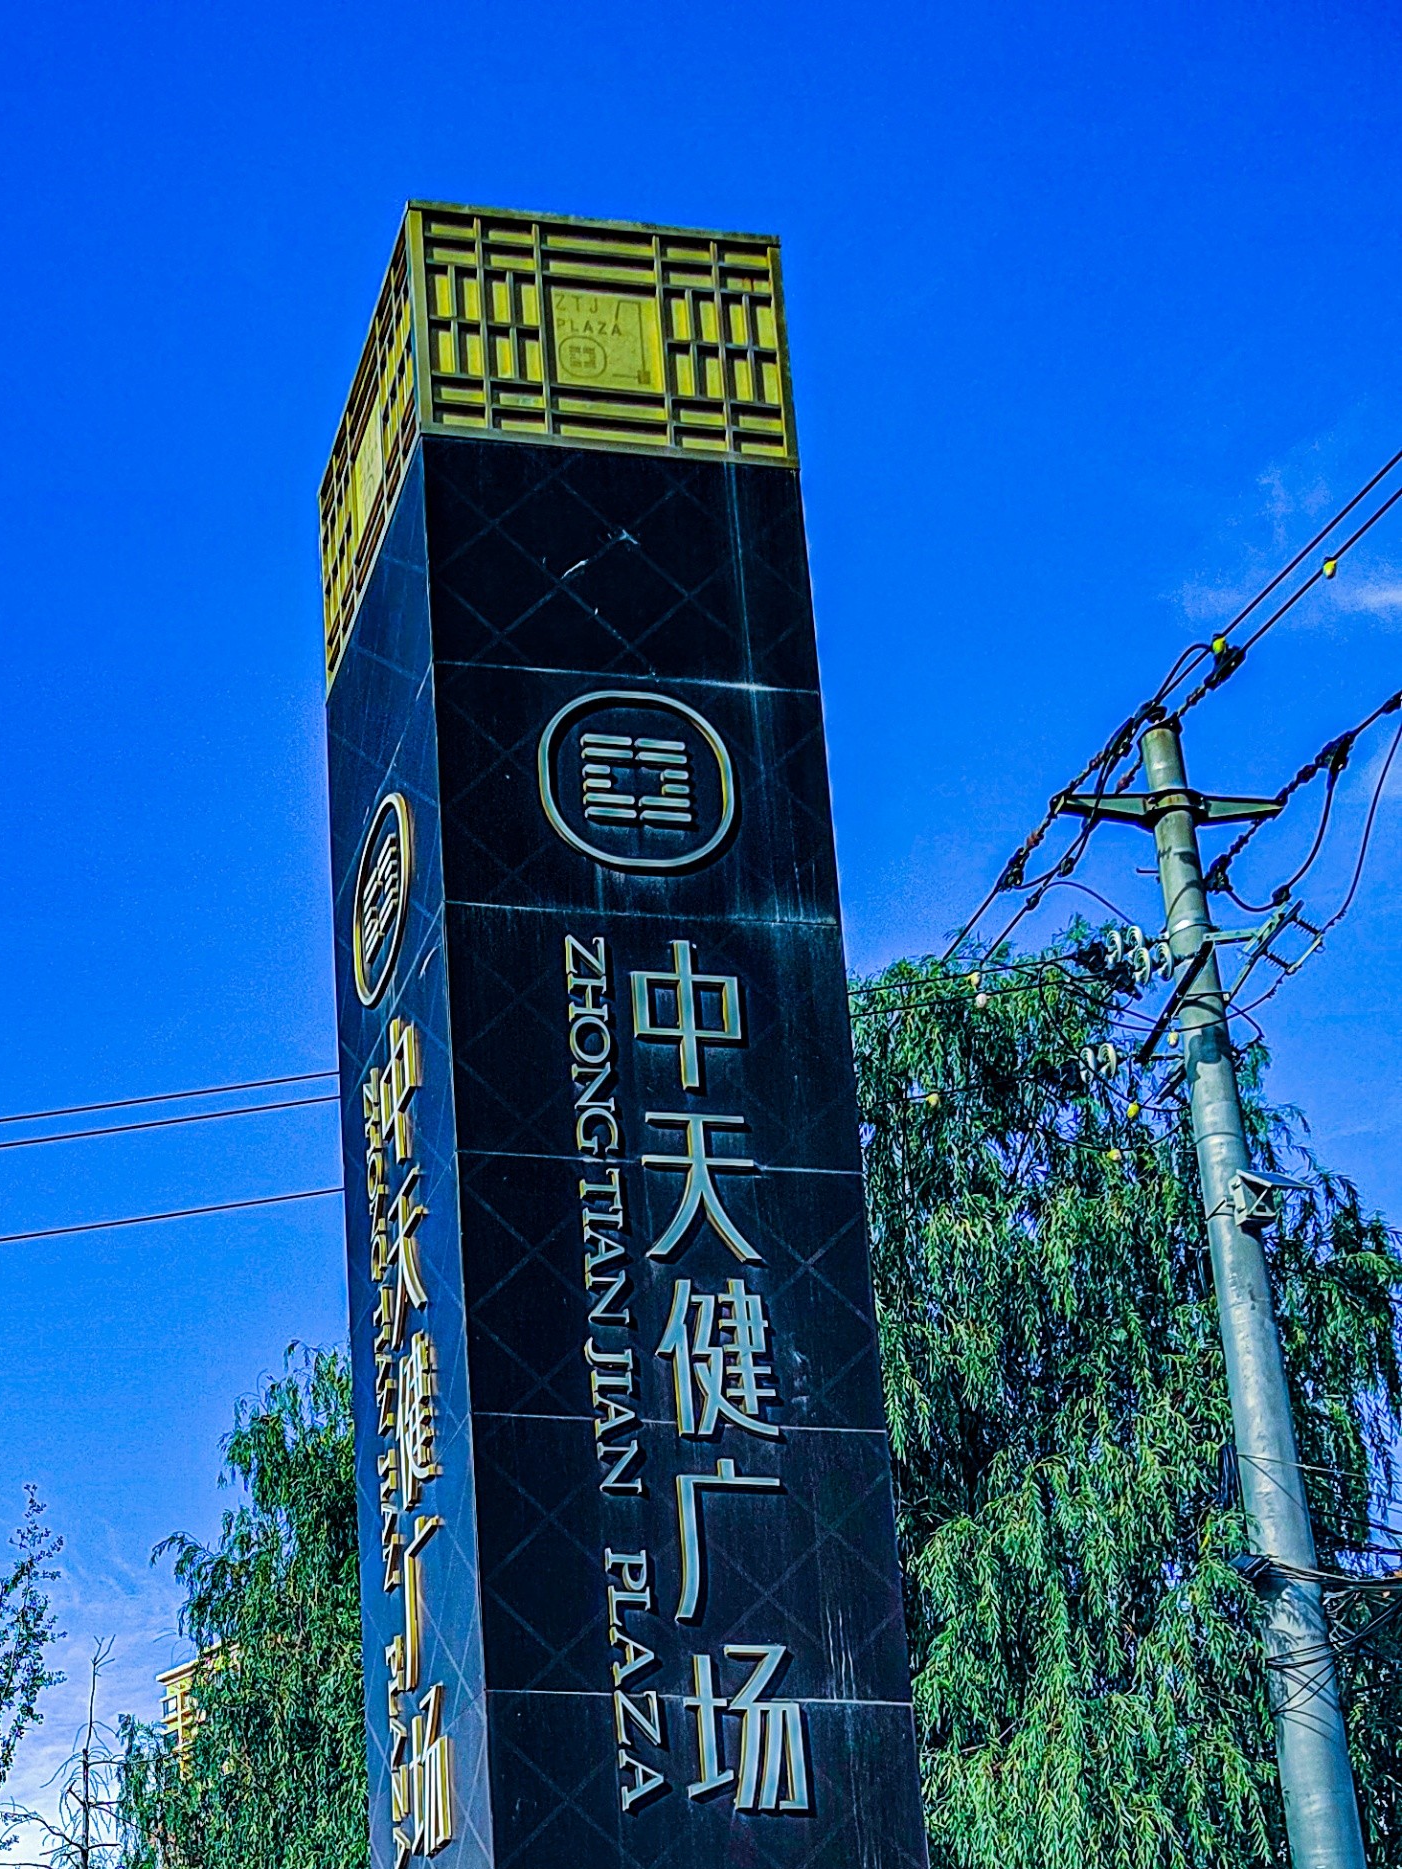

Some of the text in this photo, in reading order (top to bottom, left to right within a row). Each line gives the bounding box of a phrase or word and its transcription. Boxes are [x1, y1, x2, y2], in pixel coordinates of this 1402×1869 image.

[554, 293, 598, 314] ZTJ
[556, 317, 622, 337] PLAZA
[379, 1015, 453, 1859] 中天健广场
[564, 933, 665, 1812] ZHONG TIAN JIAN PLAZA
[630, 939, 809, 1811] 中天健广场
